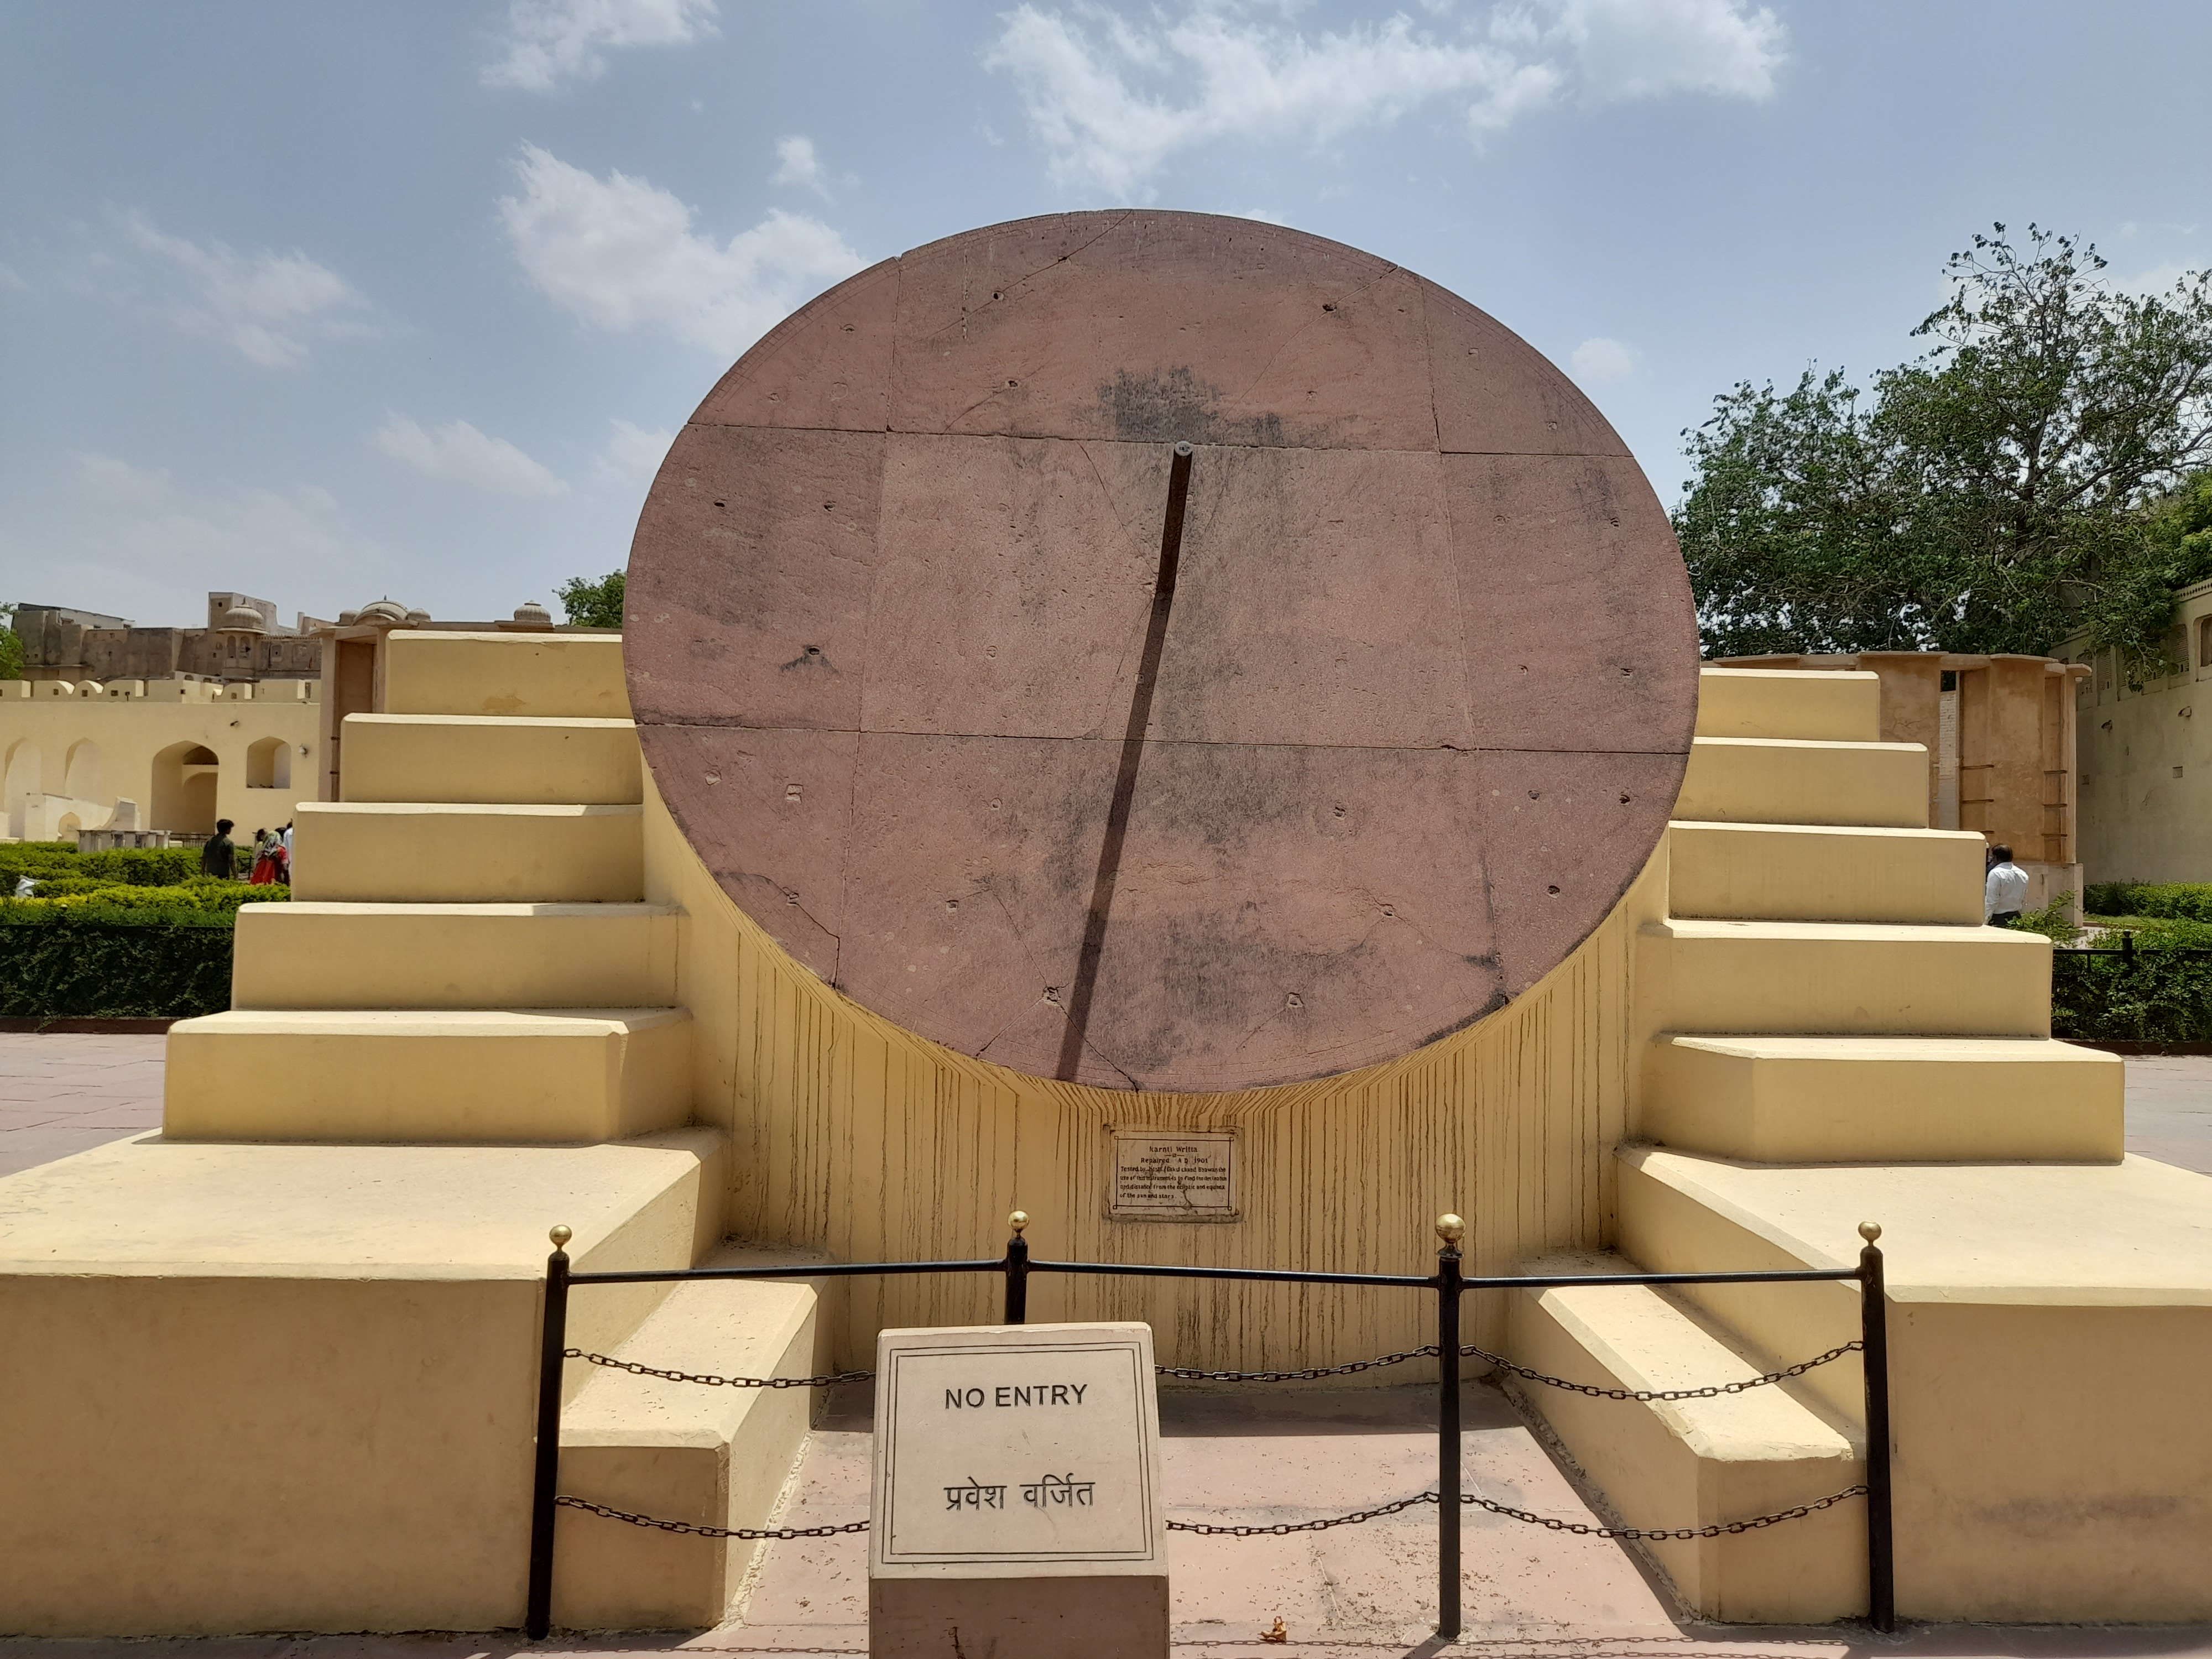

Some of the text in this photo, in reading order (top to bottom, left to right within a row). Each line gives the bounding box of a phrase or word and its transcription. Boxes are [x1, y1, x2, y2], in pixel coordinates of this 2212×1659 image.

[945, 1384, 1088, 1410] NO ENTRY
[943, 1472, 1096, 1511] प्रवेश वर्जित
